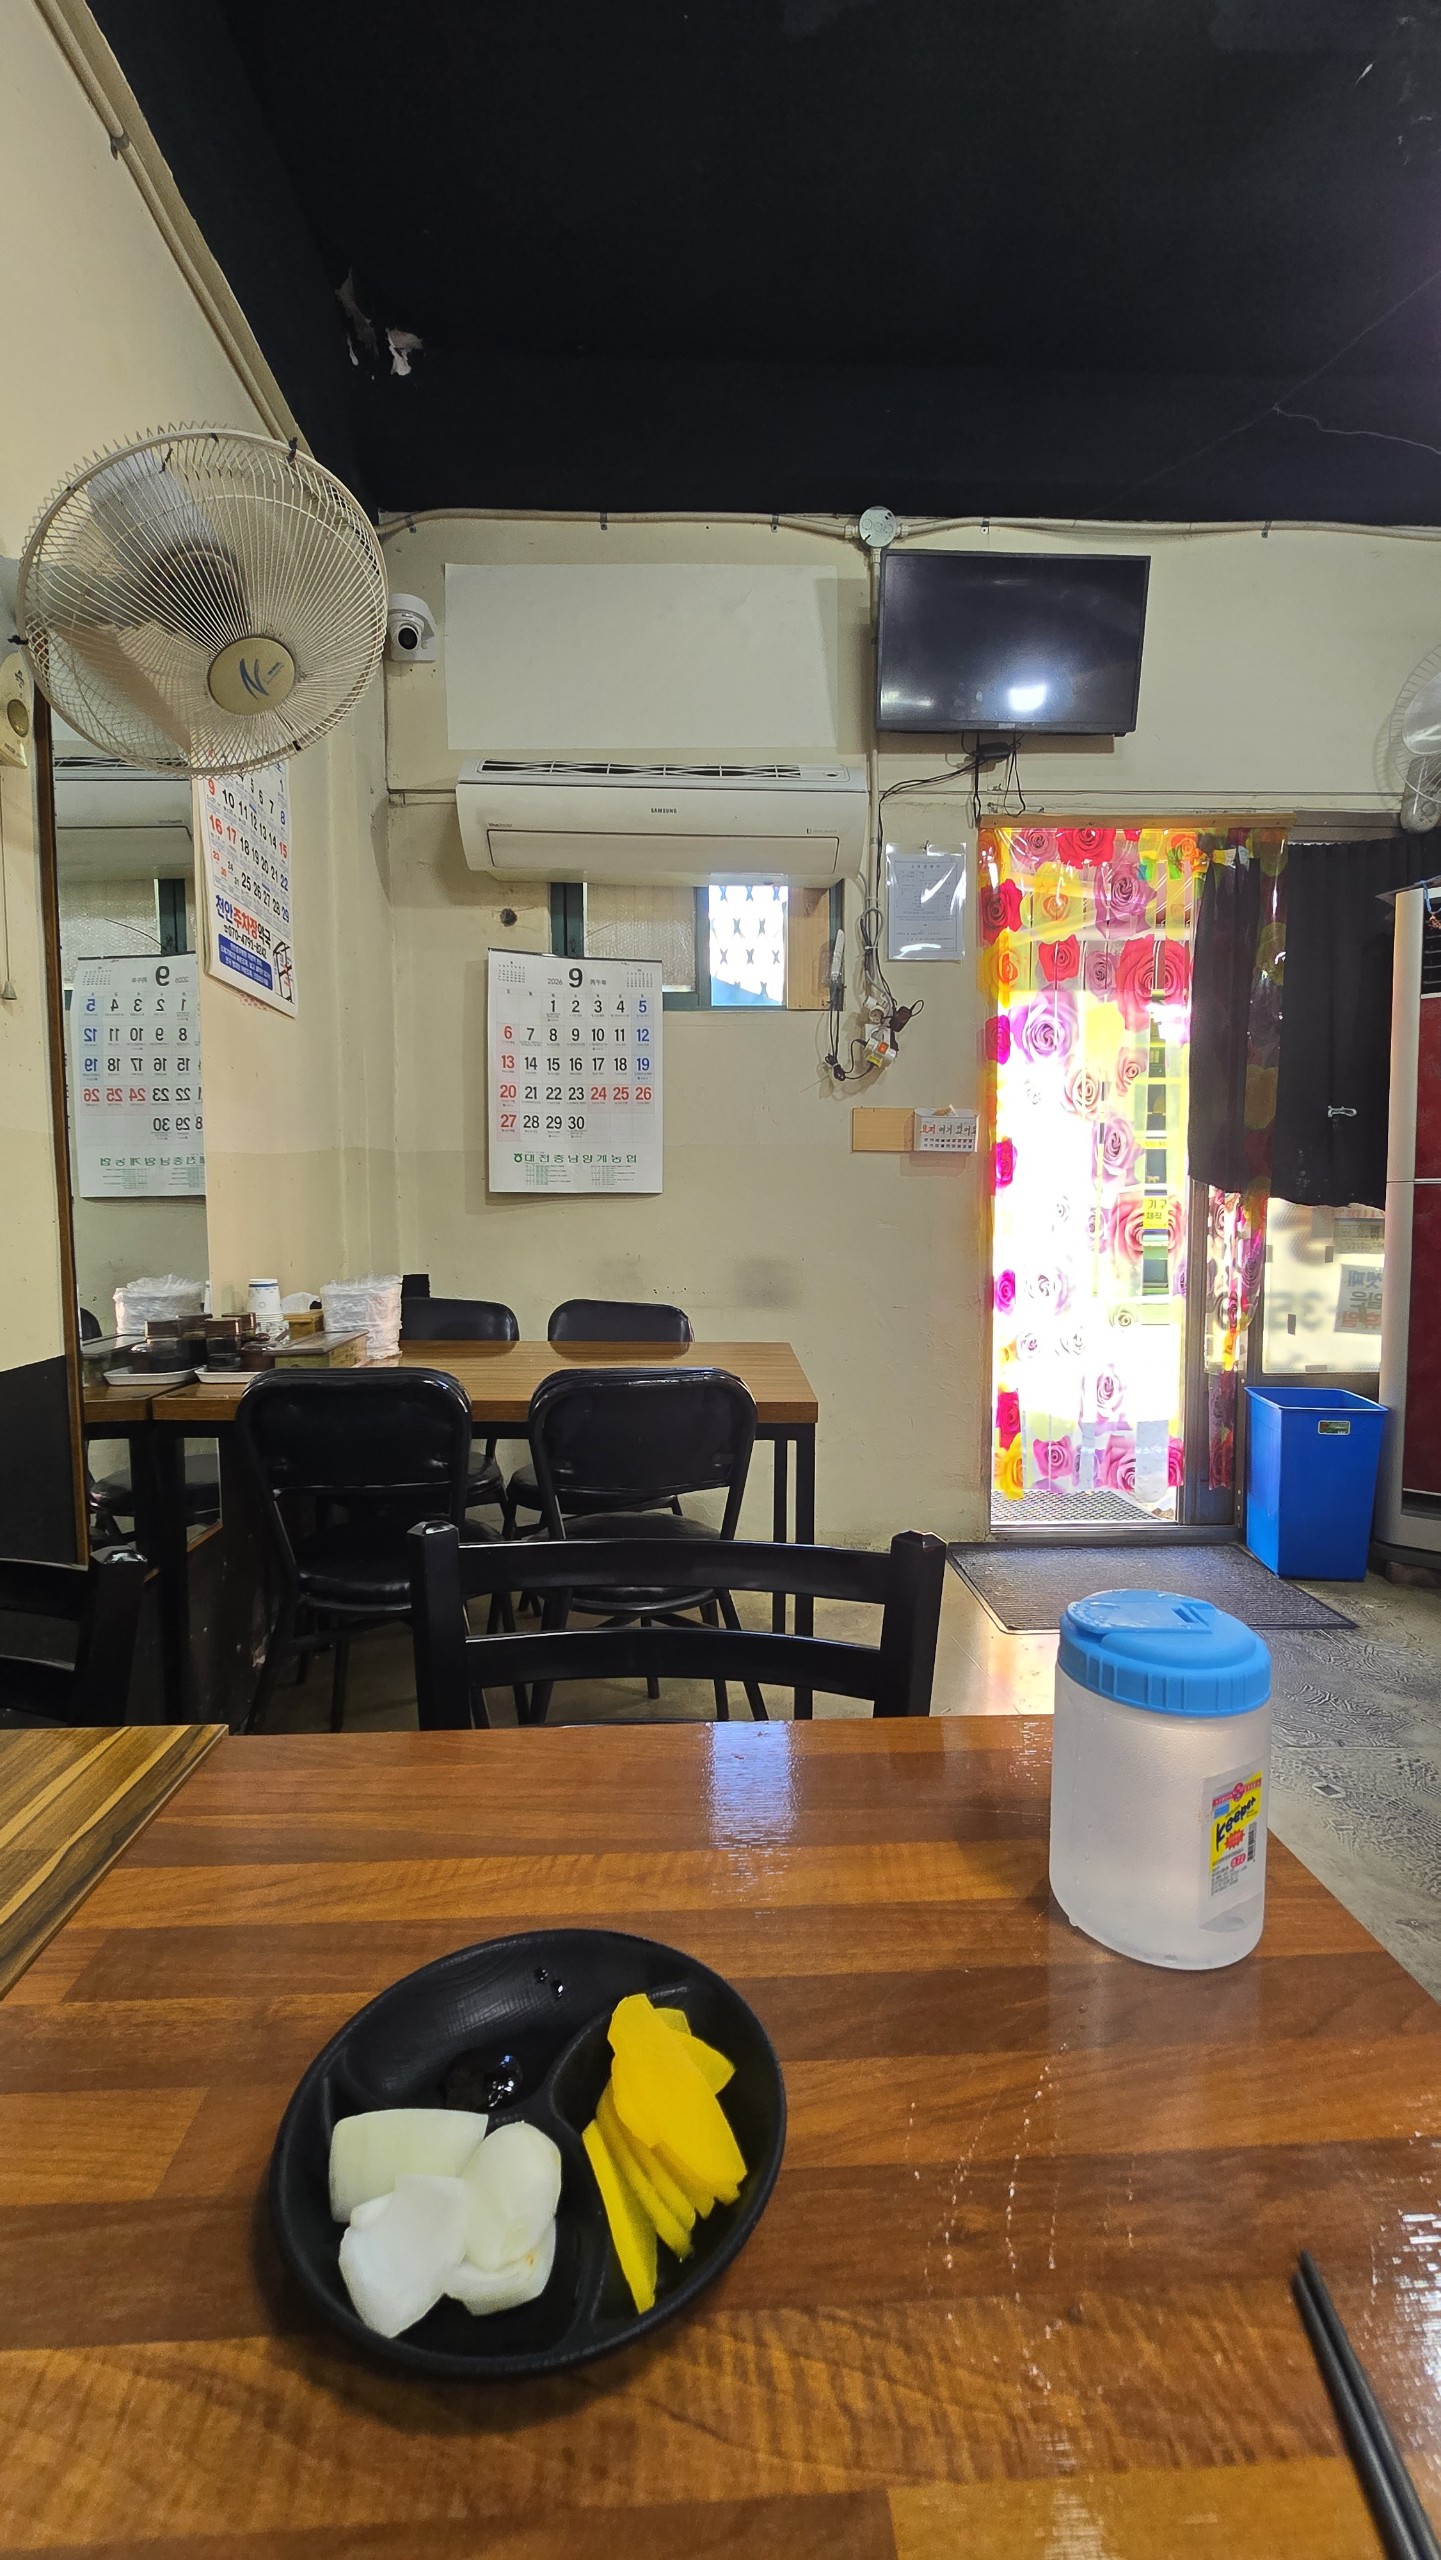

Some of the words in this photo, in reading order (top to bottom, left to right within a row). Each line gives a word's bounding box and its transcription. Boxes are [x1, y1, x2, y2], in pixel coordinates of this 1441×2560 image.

[280, 780, 283, 792] 1
[259, 790, 263, 804] 6
[270, 800, 274, 814] 7
[281, 811, 285, 824] 8
[208, 780, 215, 795] 9
[223, 789, 234, 809] 10
[239, 801, 247, 819] 11
[251, 812, 257, 831] 12
[260, 823, 266, 840] 13
[269, 833, 276, 850] 14
[280, 842, 287, 859] 15
[210, 815, 222, 835] 16
[227, 826, 236, 844] 17
[241, 837, 249, 855] 18
[252, 848, 259, 865] 19
[261, 856, 268, 874] 20
[271, 866, 278, 884] 21
[281, 874, 288, 891] 22
[213, 851, 219, 861] 23
[228, 861, 233, 871] 24
[242, 872, 251, 891] 25
[254, 882, 261, 900] 26
[263, 890, 270, 908] 27
[273, 899, 280, 915] 28
[282, 906, 289, 922] 29
[569, 968, 583, 988] 9
[551, 1000, 555, 1012] 1
[572, 1000, 579, 1012] 2
[594, 1000, 602, 1012] 3
[616, 1000, 624, 1012] 4
[638, 1000, 646, 1013] 5
[504, 1026, 512, 1039] 6
[526, 1028, 534, 1040] 7
[549, 1028, 557, 1042] 8
[571, 1028, 579, 1042] 9
[591, 1028, 604, 1042] 10
[615, 1029, 624, 1042] 11
[637, 1029, 649, 1042] 12
[501, 1055, 515, 1068] 13
[525, 1057, 537, 1070] 14
[547, 1058, 560, 1071] 15
[570, 1058, 582, 1071] 16
[592, 1058, 604, 1071] 17
[614, 1058, 627, 1071] 18
[637, 1058, 649, 1071] 19
[500, 1085, 516, 1098] 20
[525, 1086, 537, 1099] 21
[546, 1087, 562, 1100] 22
[568, 1087, 584, 1100] 23
[590, 1087, 607, 1100] 24
[613, 1087, 629, 1100] 25
[635, 1087, 652, 1100] 26
[500, 1115, 517, 1128] 27
[523, 1115, 540, 1128] 28
[546, 1116, 562, 1129] 29
[568, 1116, 584, 1129] 30
[920, 1124, 935, 1134] 요지
